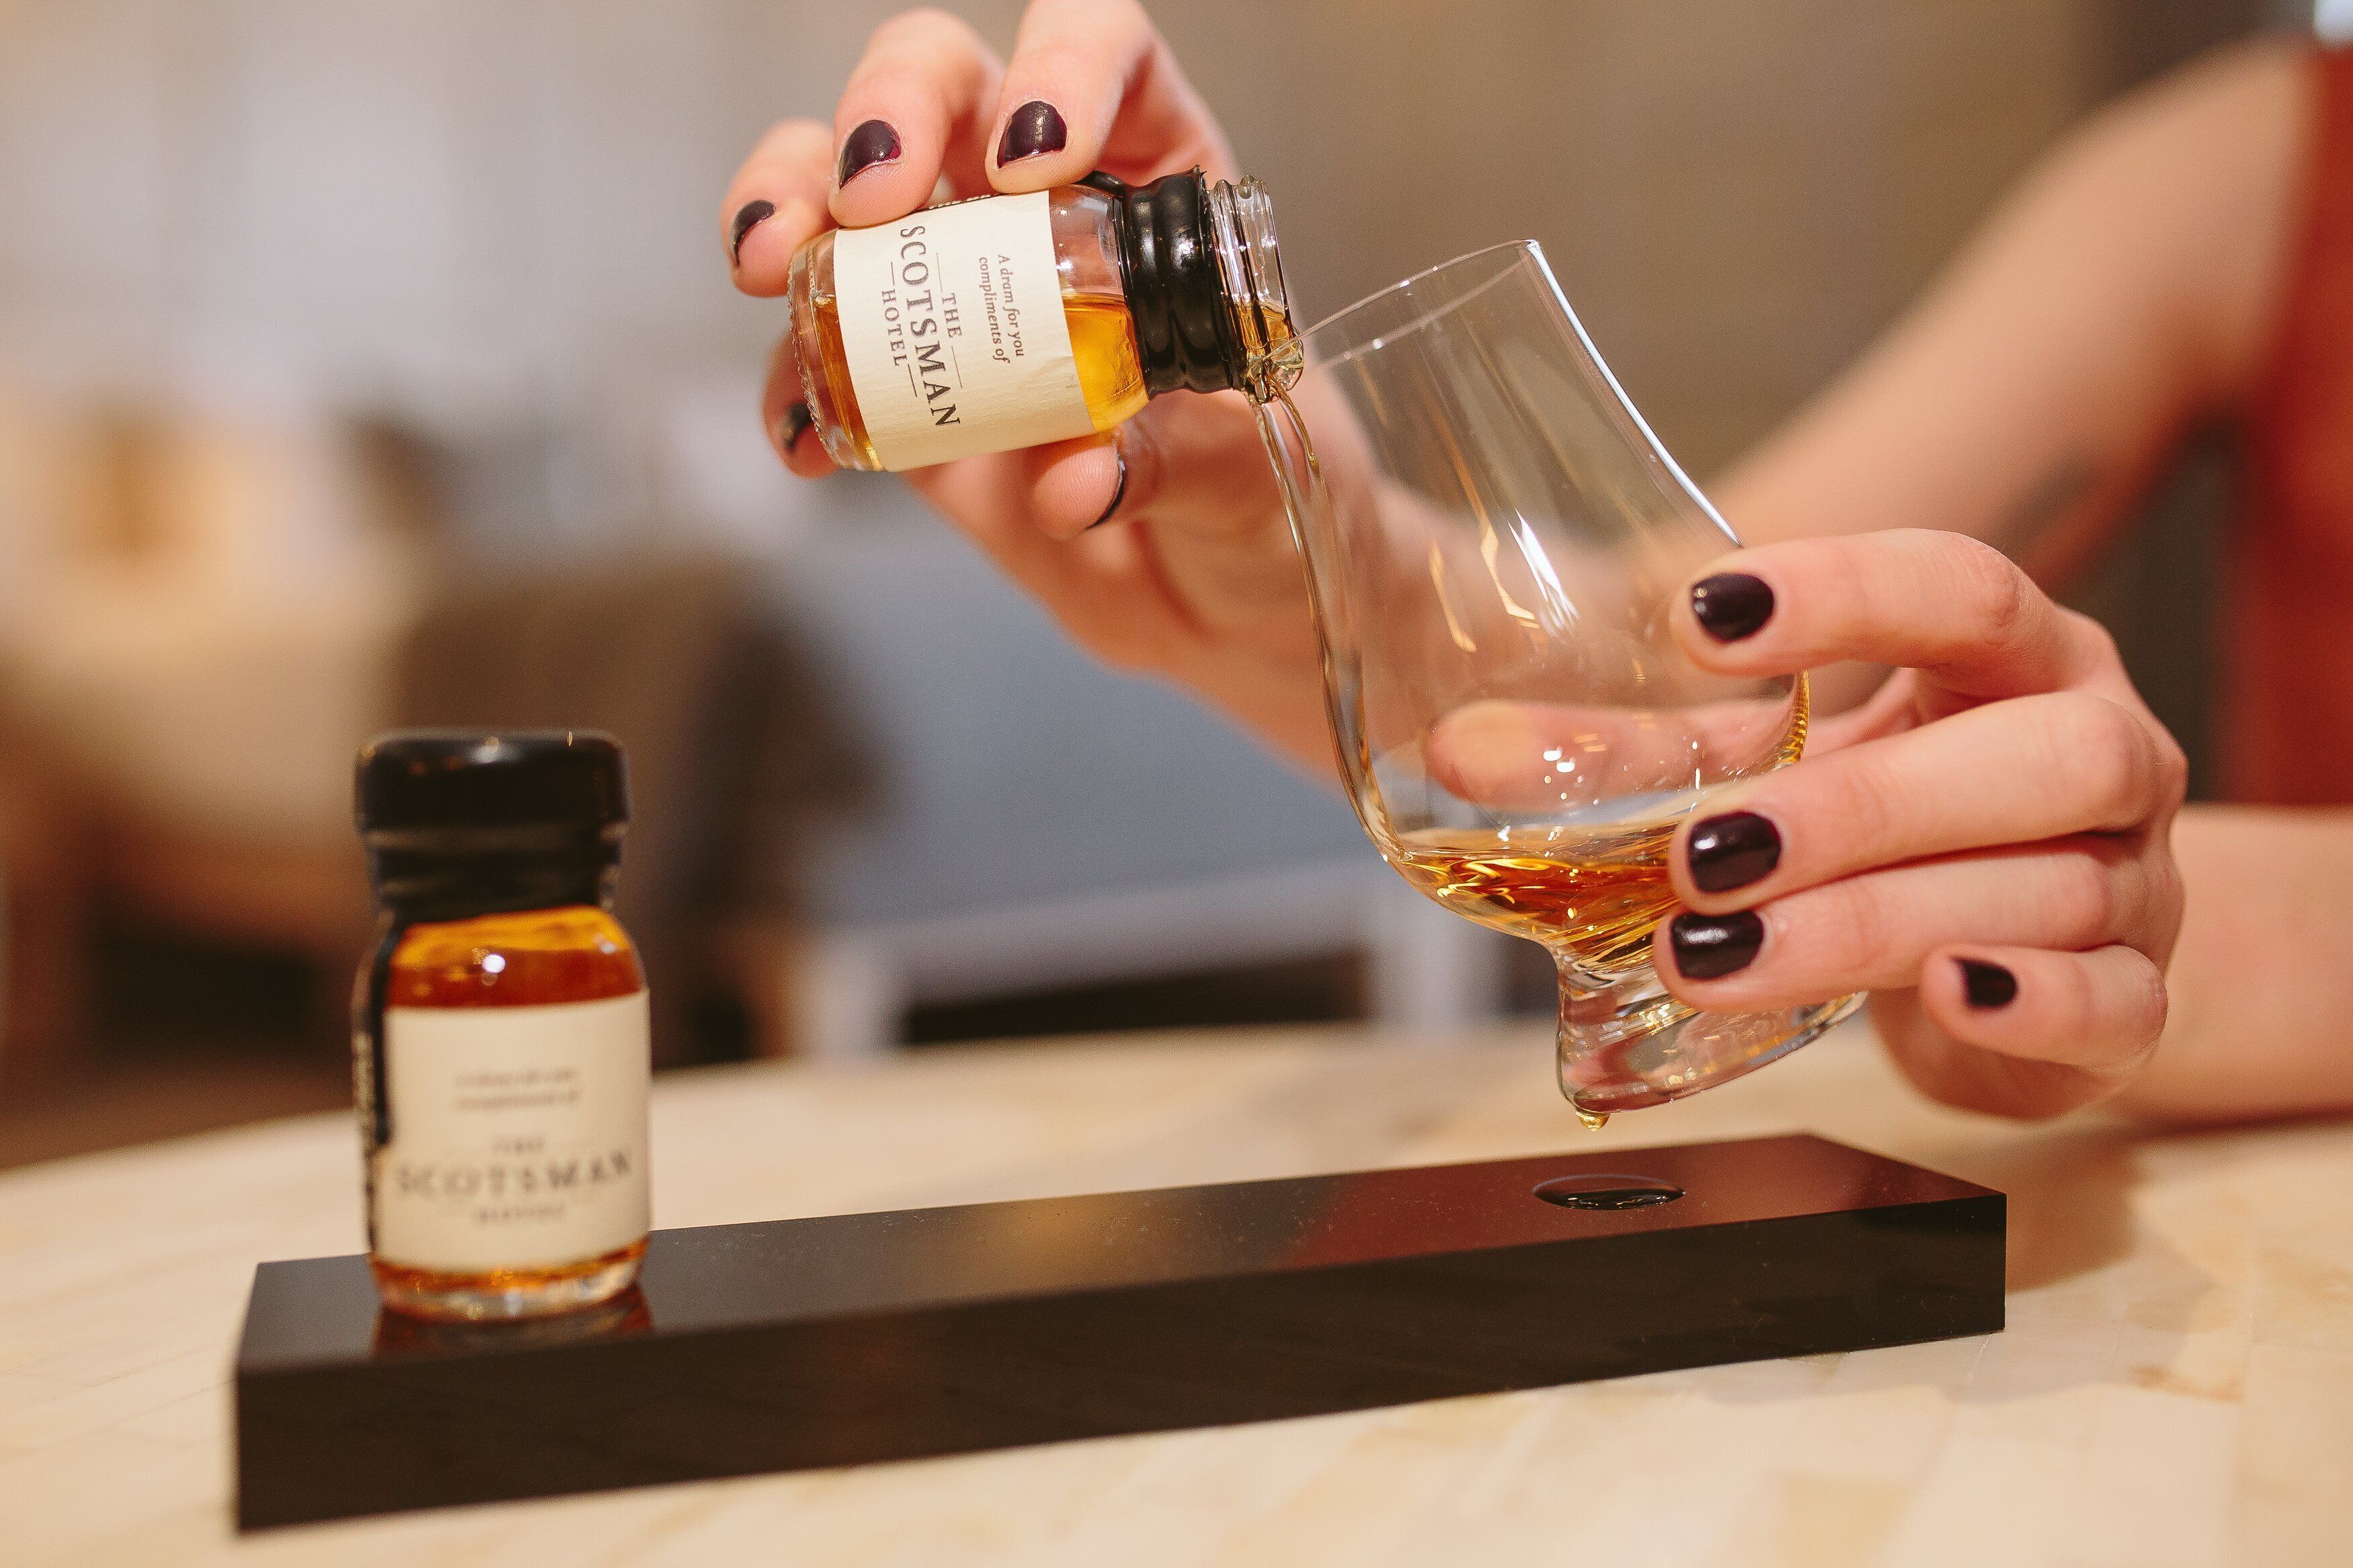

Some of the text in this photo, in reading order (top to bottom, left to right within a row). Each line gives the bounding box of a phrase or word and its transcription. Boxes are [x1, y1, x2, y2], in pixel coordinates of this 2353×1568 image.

[881, 289, 908, 366] HOTEL
[900, 226, 961, 427] SCOTSMAN
[942, 293, 962, 338] THE
[979, 257, 1010, 364] compliments of
[998, 254, 1025, 357] A dram for you
[397, 1146, 631, 1198] SCOTSMAN
